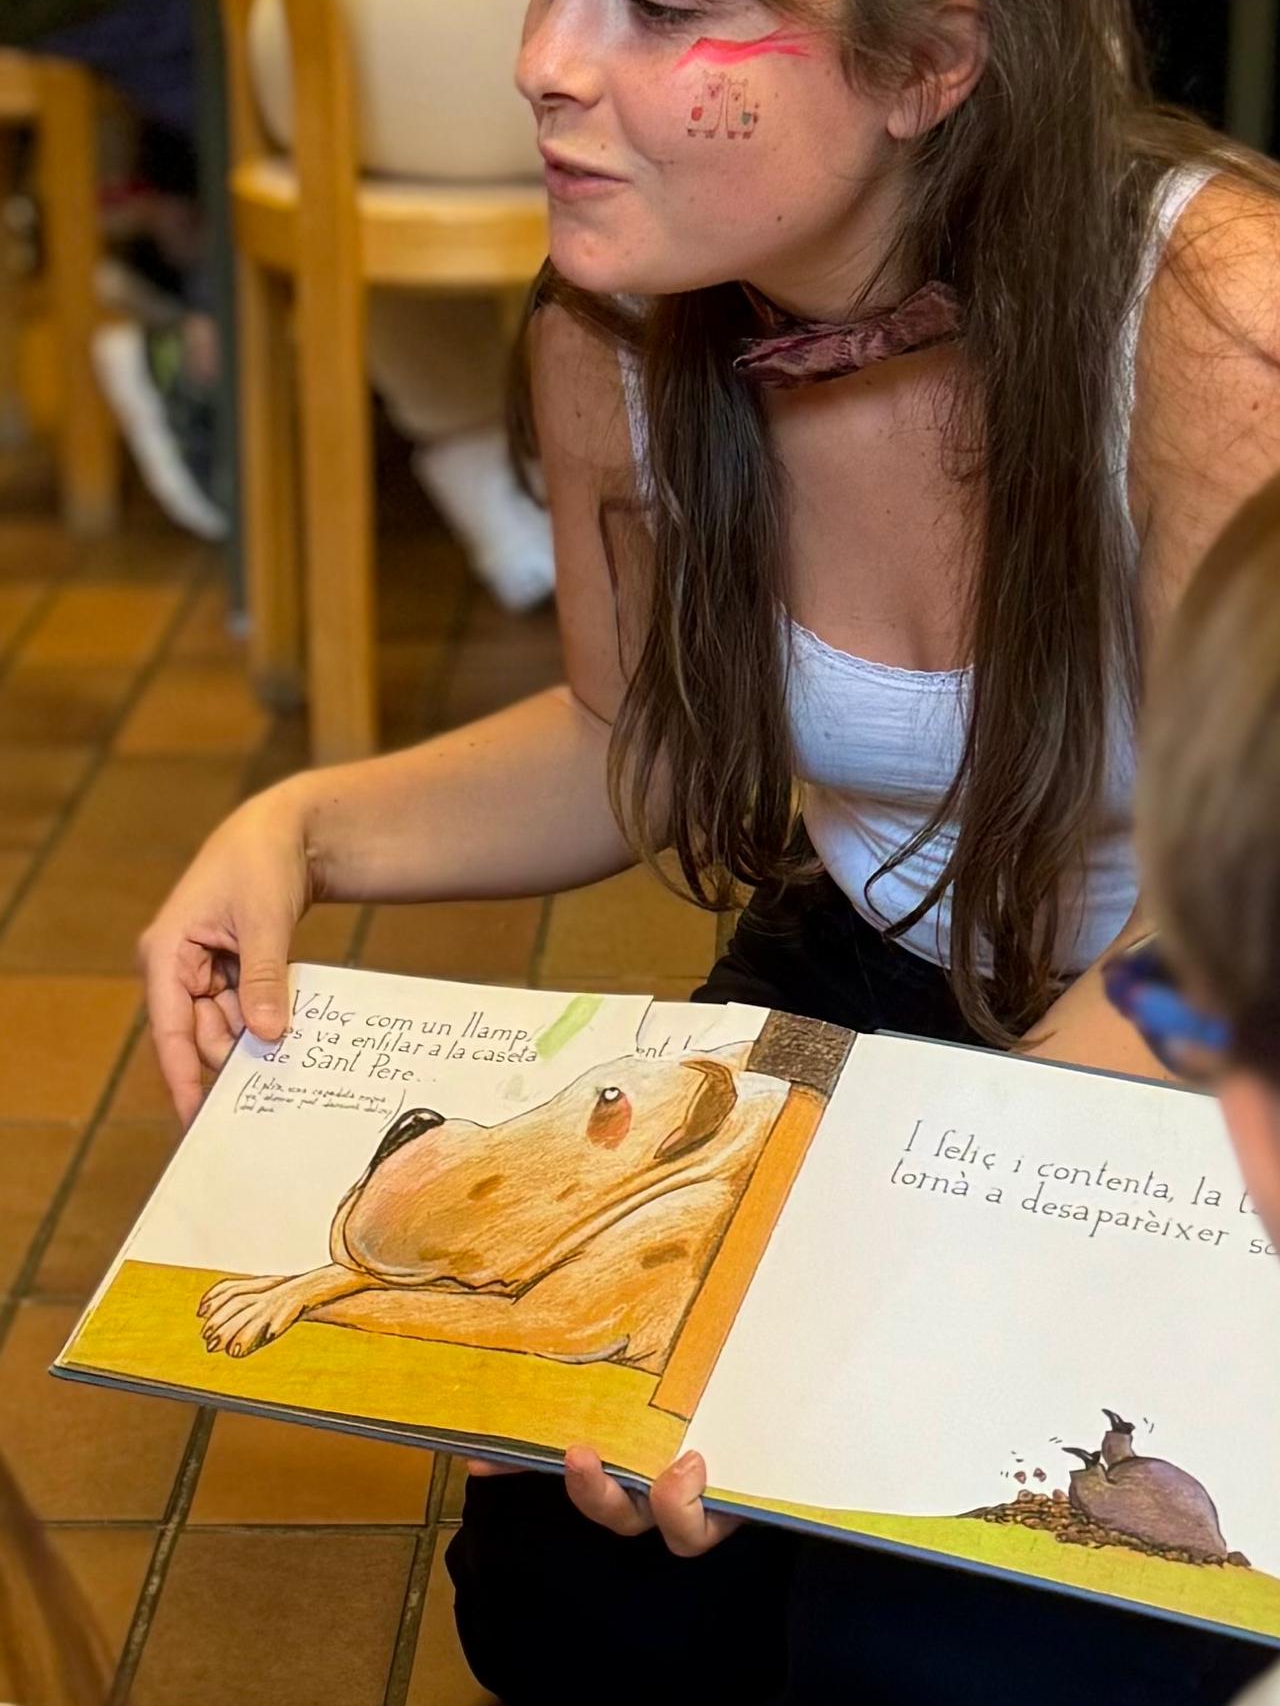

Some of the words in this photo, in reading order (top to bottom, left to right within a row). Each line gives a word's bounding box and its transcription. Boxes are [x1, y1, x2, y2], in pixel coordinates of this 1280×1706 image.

[293, 990, 355, 1026] Veloç
[366, 1014, 419, 1032] com
[422, 1021, 451, 1036] un
[263, 1041, 290, 1065] de
[301, 1046, 361, 1073] Sant
[317, 1030, 340, 1045] va
[352, 1032, 423, 1056] enfilar
[428, 1045, 440, 1057] a
[445, 1040, 465, 1060] la
[472, 1043, 538, 1063] caseta
[904, 1120, 923, 1152] I
[934, 1129, 996, 1170] feliç
[1013, 1155, 1025, 1173] i
[1037, 1160, 1173, 1203] contenta,
[1191, 1176, 1222, 1207] la
[1239, 1189, 1263, 1215] t
[890, 1158, 969, 1196] tornà
[985, 1187, 1003, 1204] a
[1021, 1181, 1230, 1246] desaparèixer
